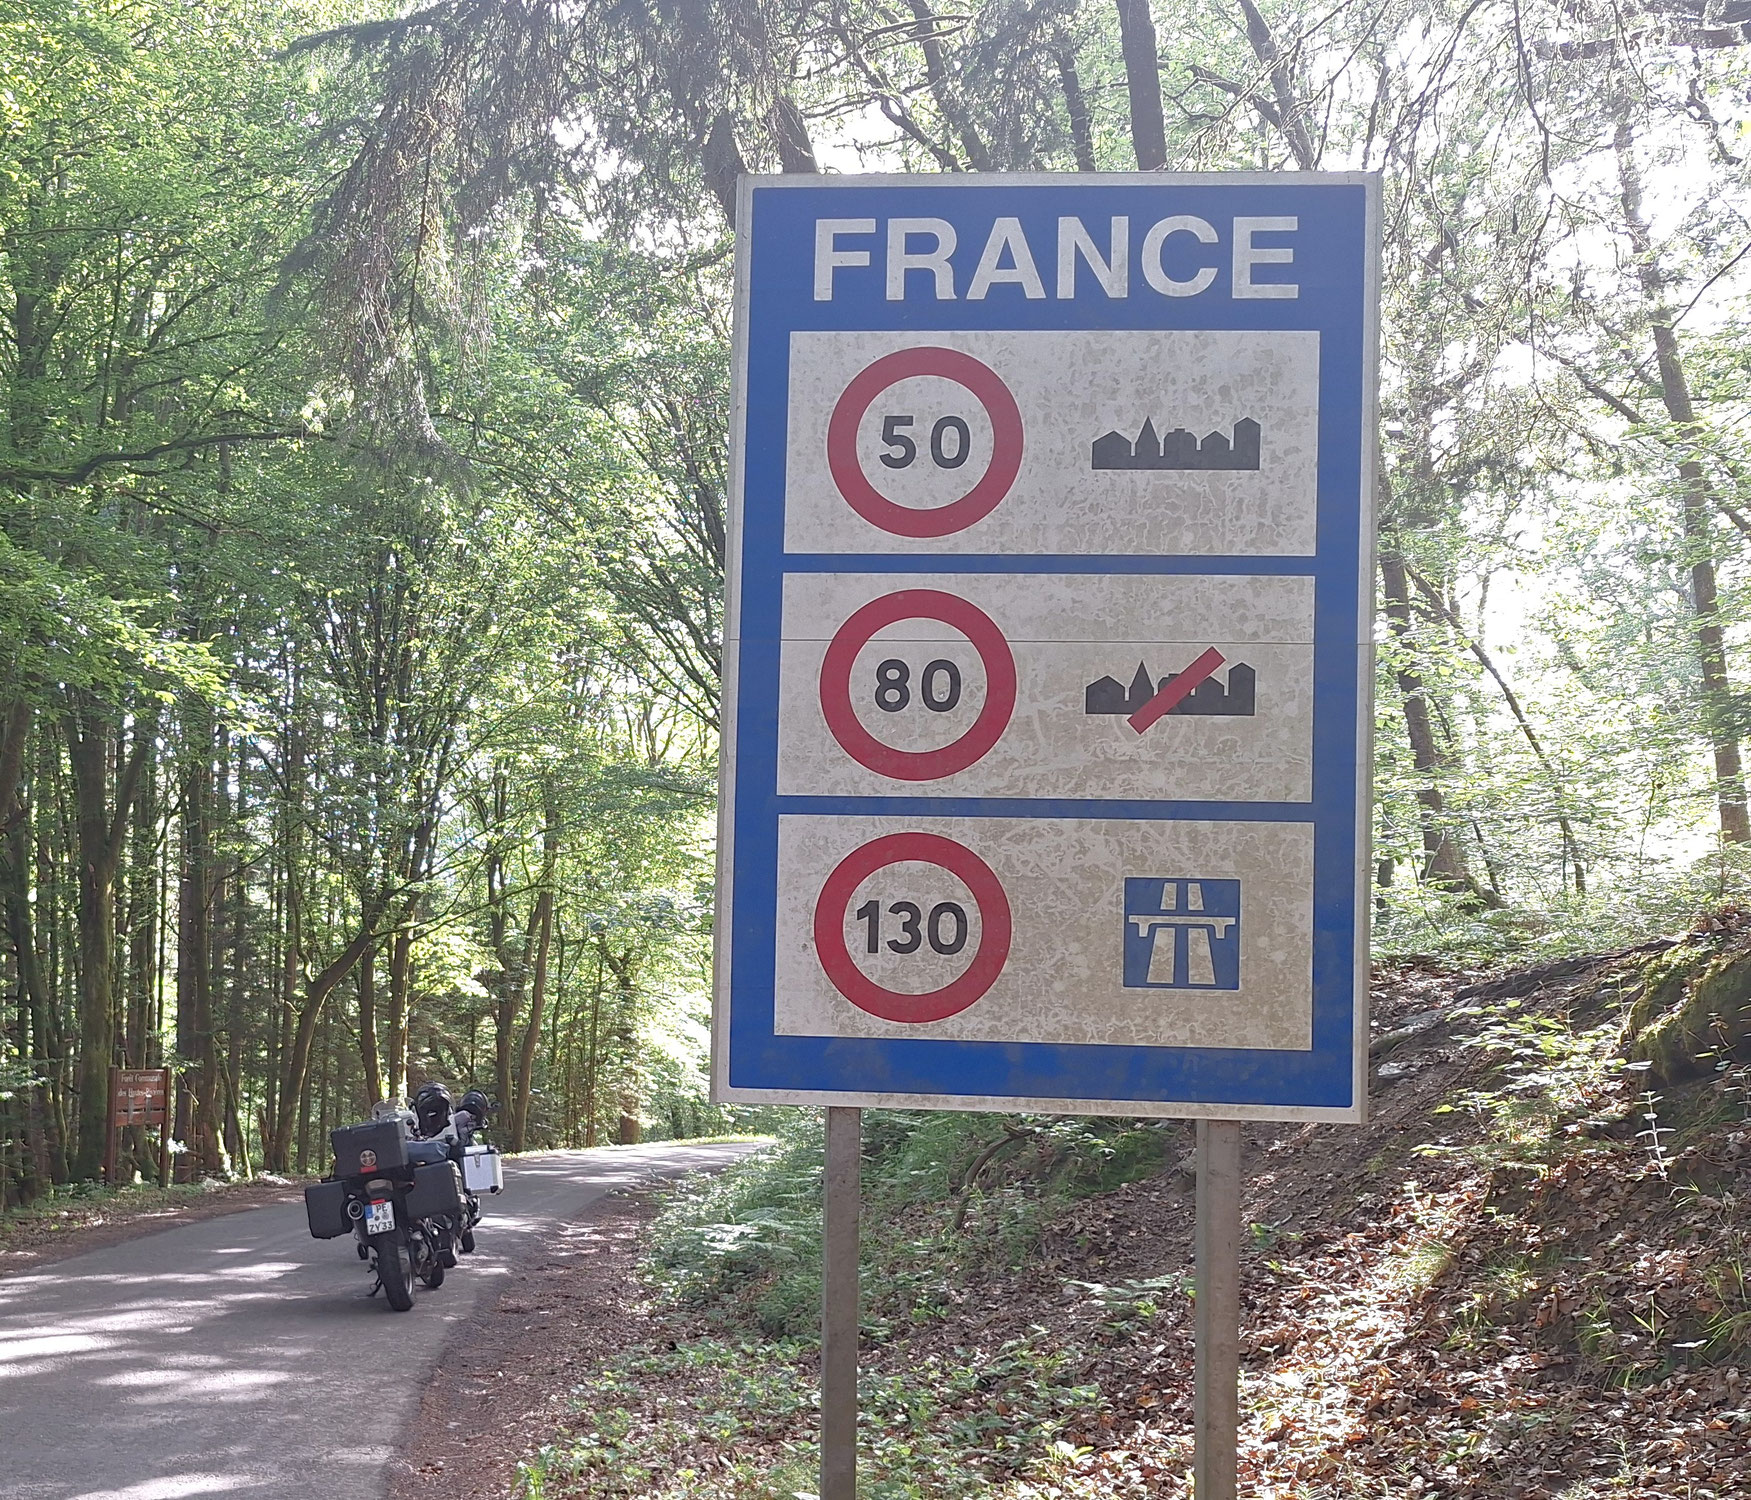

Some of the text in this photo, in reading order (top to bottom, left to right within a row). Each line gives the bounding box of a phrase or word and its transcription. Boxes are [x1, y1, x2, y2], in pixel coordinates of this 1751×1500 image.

[813, 215, 1300, 302] FRANCE
[880, 416, 971, 469] 50
[875, 659, 962, 713] 80
[855, 899, 969, 956] 130
[376, 1203, 388, 1213] PE
